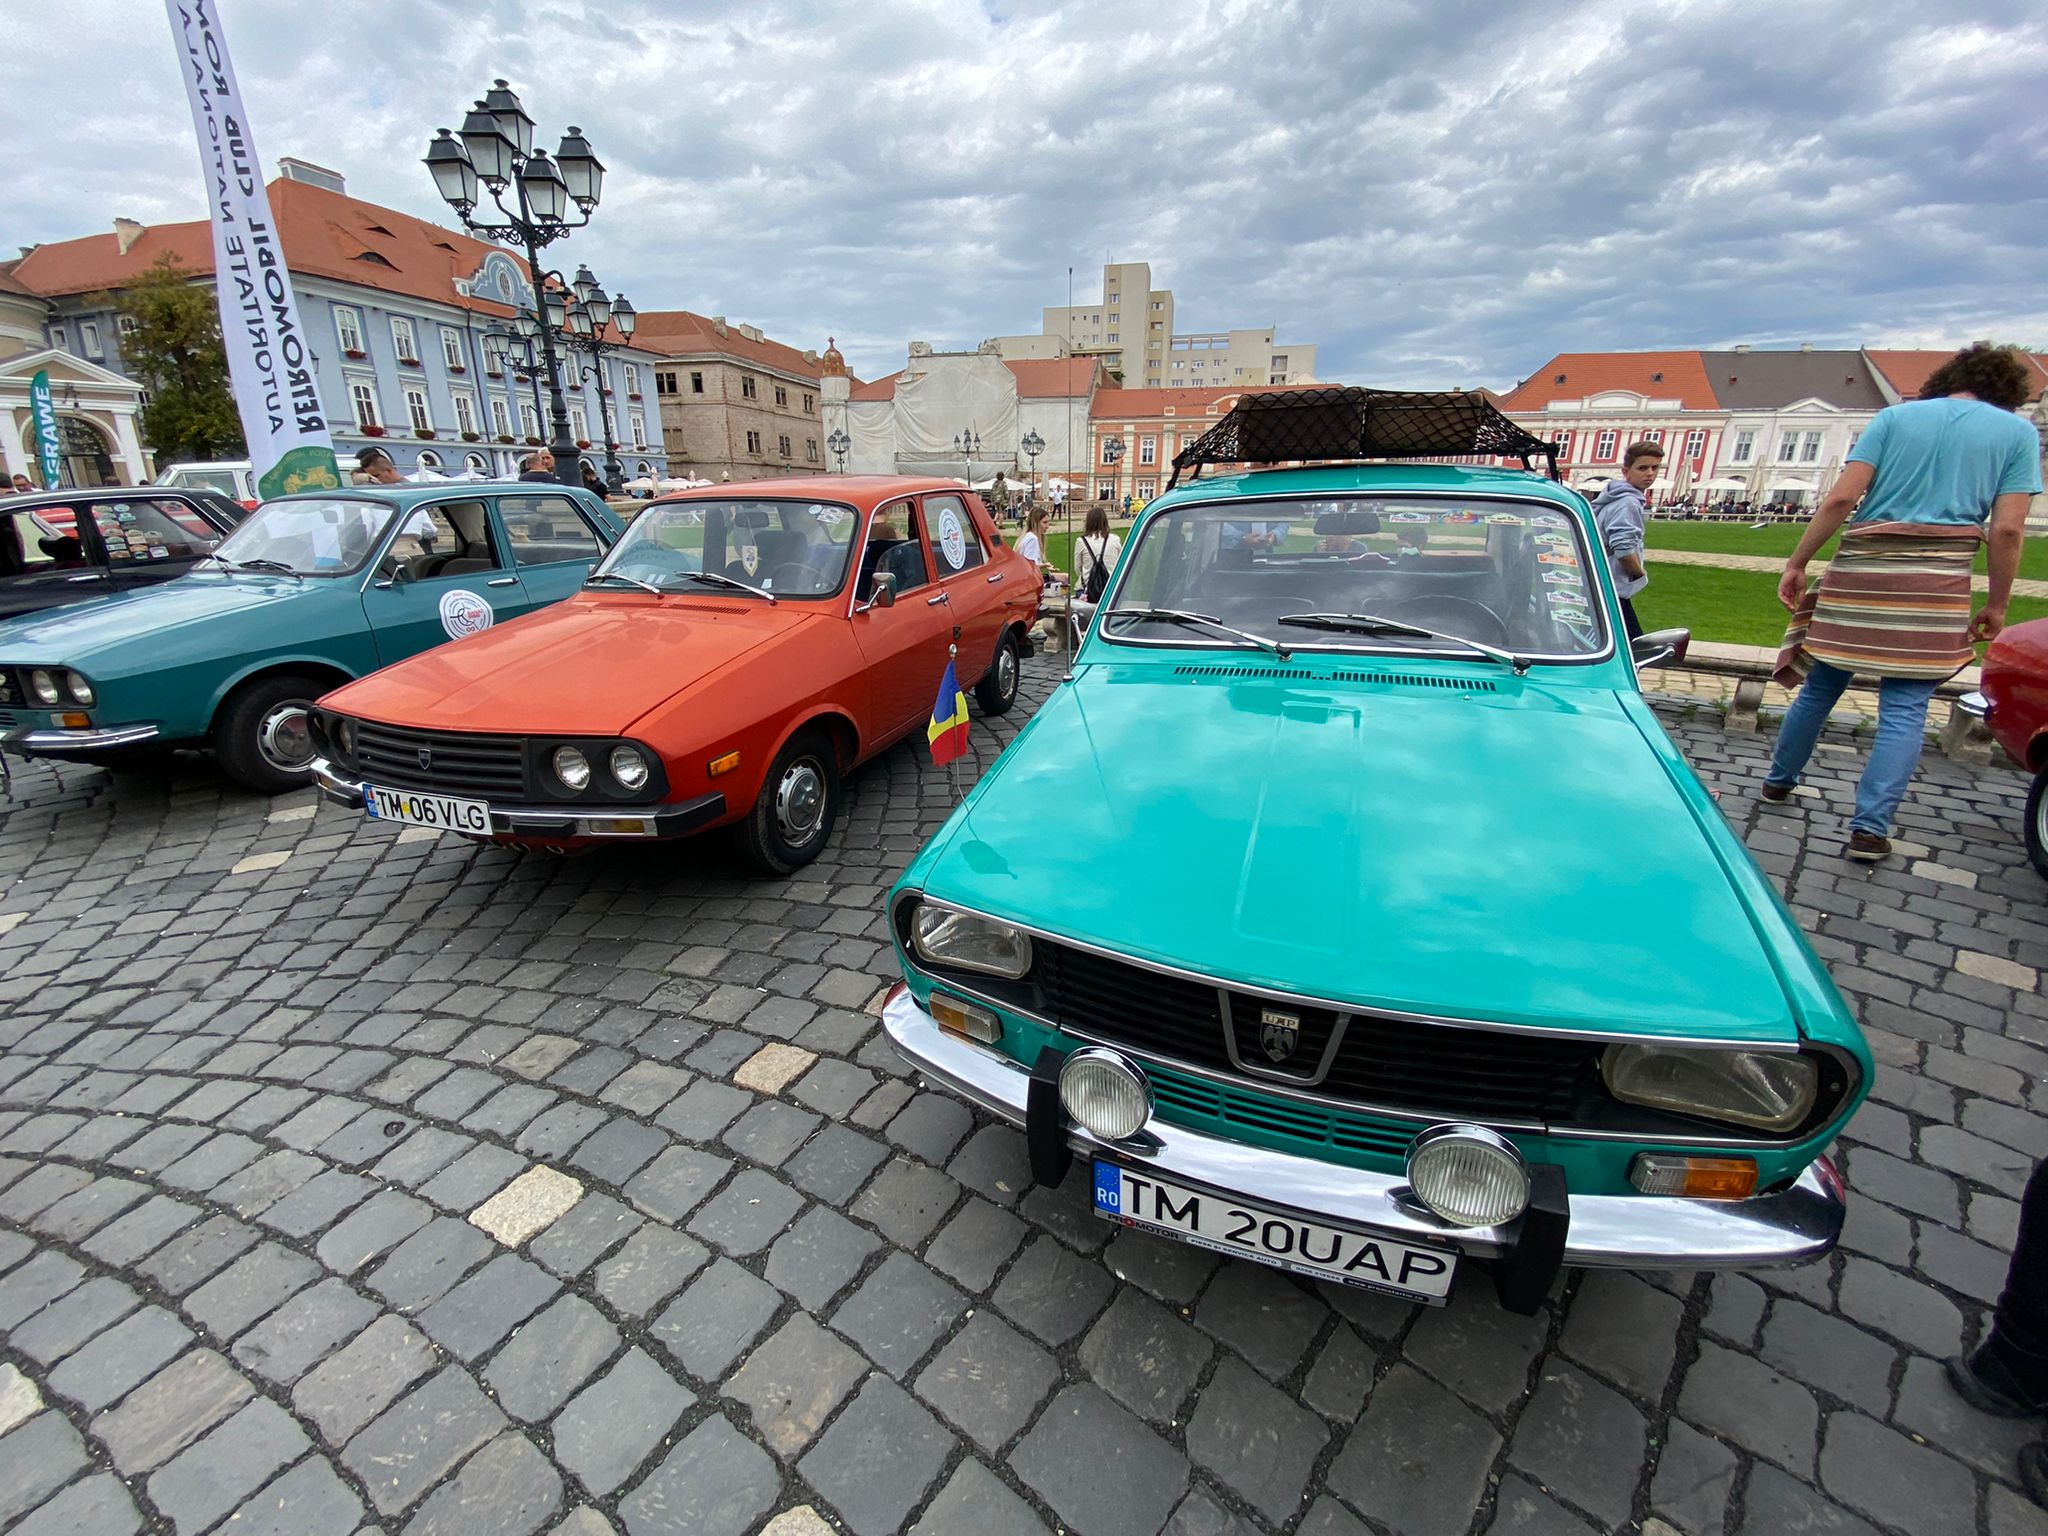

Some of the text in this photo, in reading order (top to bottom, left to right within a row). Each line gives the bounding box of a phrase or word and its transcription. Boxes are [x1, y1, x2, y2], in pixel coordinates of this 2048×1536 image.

[36, 386, 60, 474] GRAWE
[376, 791, 405, 819] TM
[1097, 1186, 1118, 1207] RO
[1122, 1173, 1200, 1231] TM
[1107, 1213, 1179, 1240] PROMOTOR
[1222, 1247, 1255, 1259] SERVICE
[1256, 1256, 1277, 1265] AUTO
